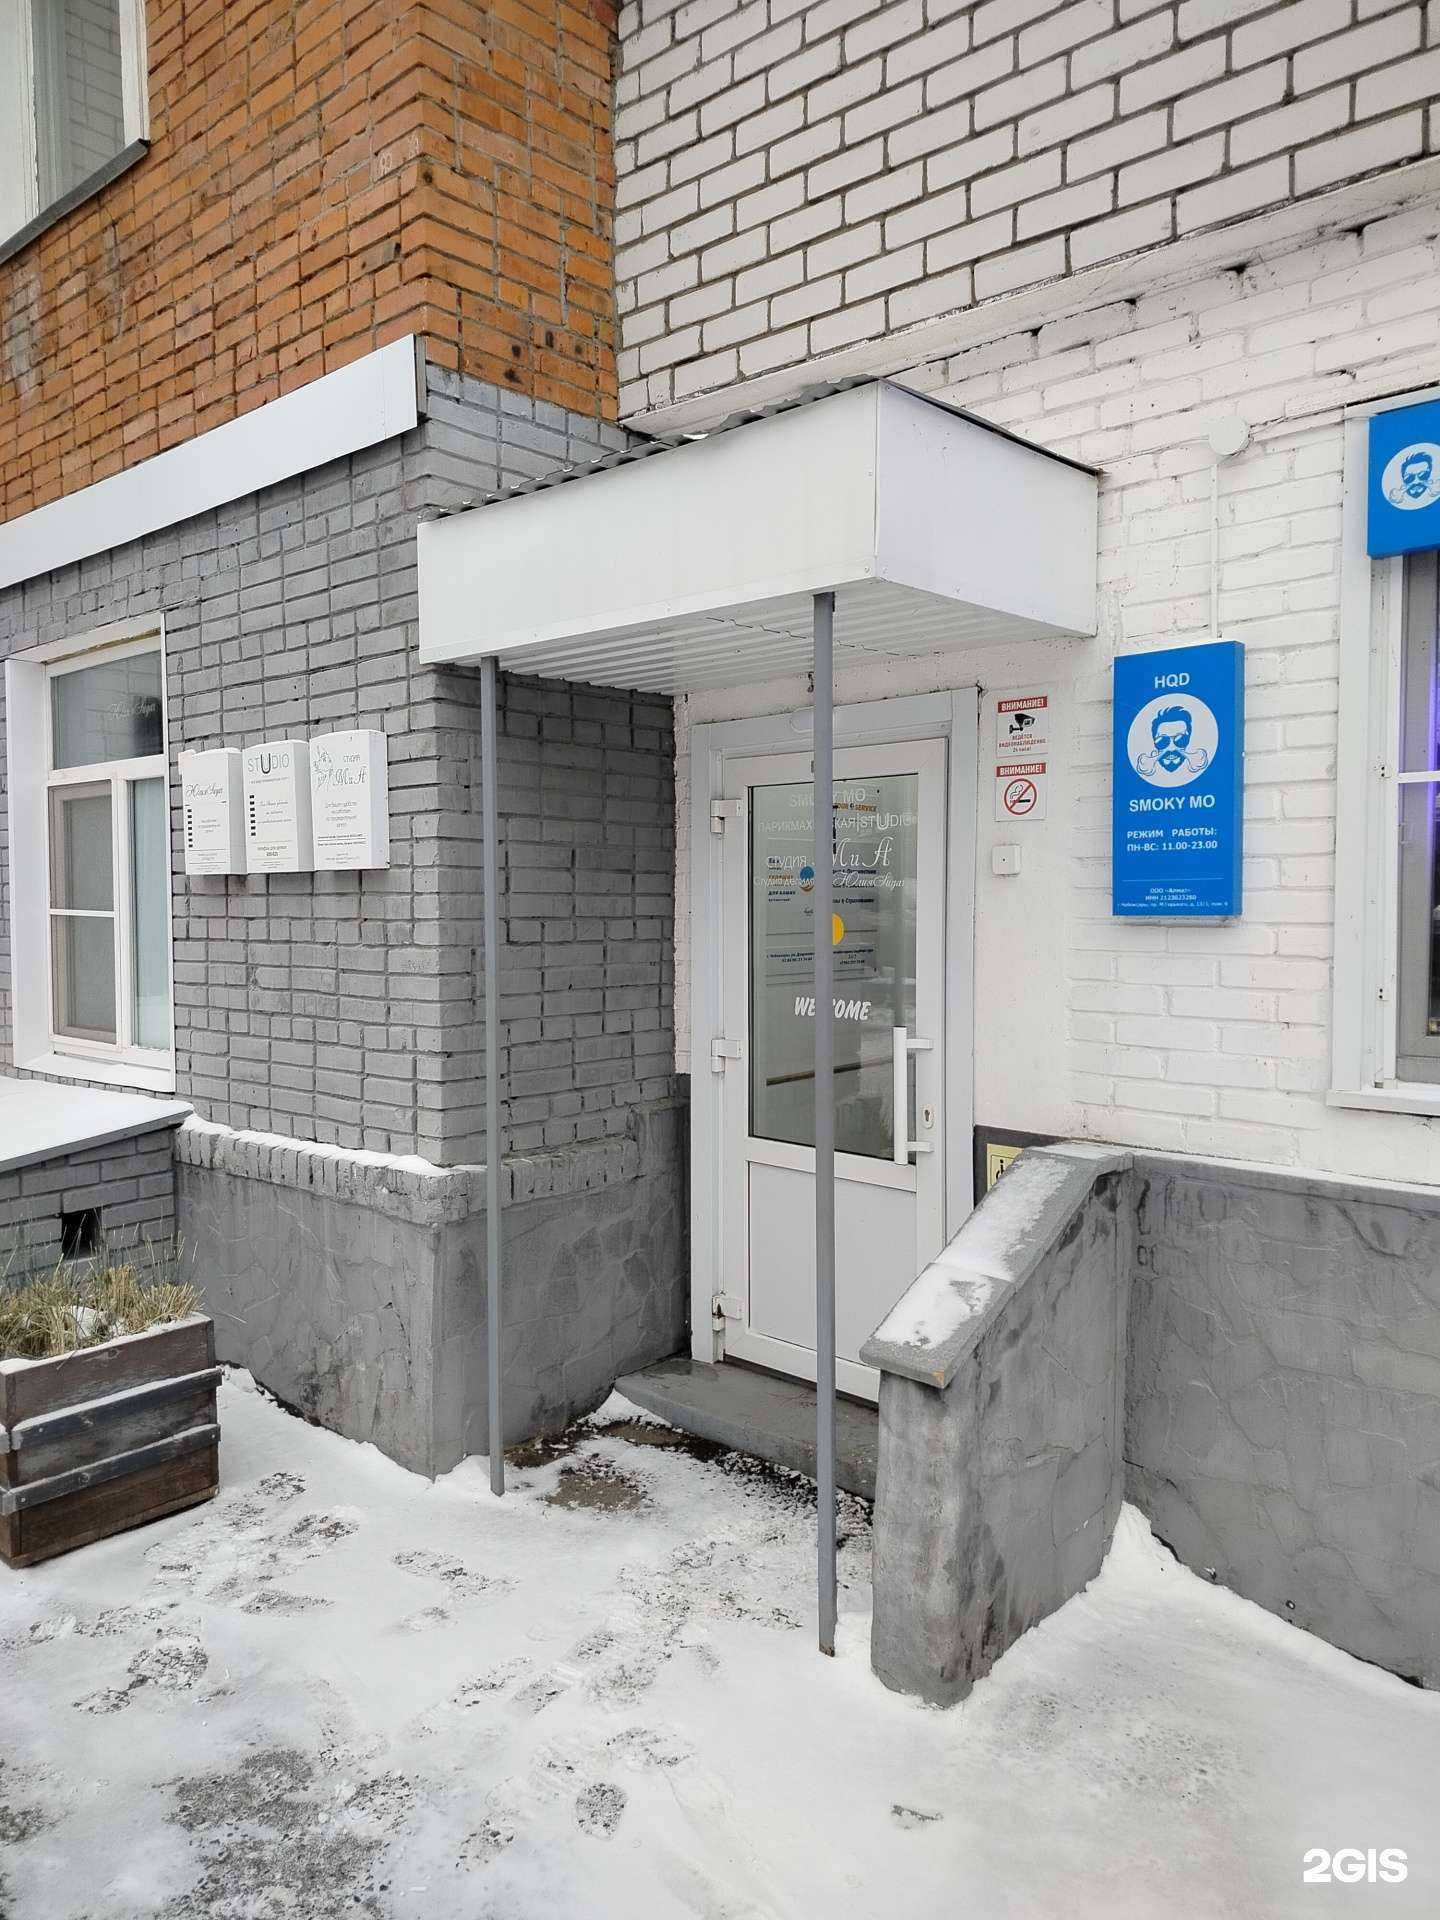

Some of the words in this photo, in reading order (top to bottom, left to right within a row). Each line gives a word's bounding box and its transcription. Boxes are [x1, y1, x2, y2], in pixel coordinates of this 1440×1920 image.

[1154, 672, 1191, 689] HQD
[1001, 699, 1044, 711] ВНИМАНИЕ!
[247, 752, 290, 775] STUDIO
[999, 766, 1042, 776] ВНИМАНИЕ!
[843, 788, 866, 803] MO
[1128, 797, 1186, 813] SMOKY
[1190, 794, 1216, 809] MO
[758, 816, 856, 832] ПАРИКМАХКАЯ
[862, 812, 912, 831] STUDIO
[1127, 830, 1164, 839] РЕЖИМ
[1171, 827, 1218, 838] РАБОТЫ:
[1127, 843, 1159, 852] ПН-ВС:
[1162, 840, 1218, 851] 11.00-23.00
[767, 855, 807, 870] СТУДИЯ
[795, 997, 872, 1021] WEOME
